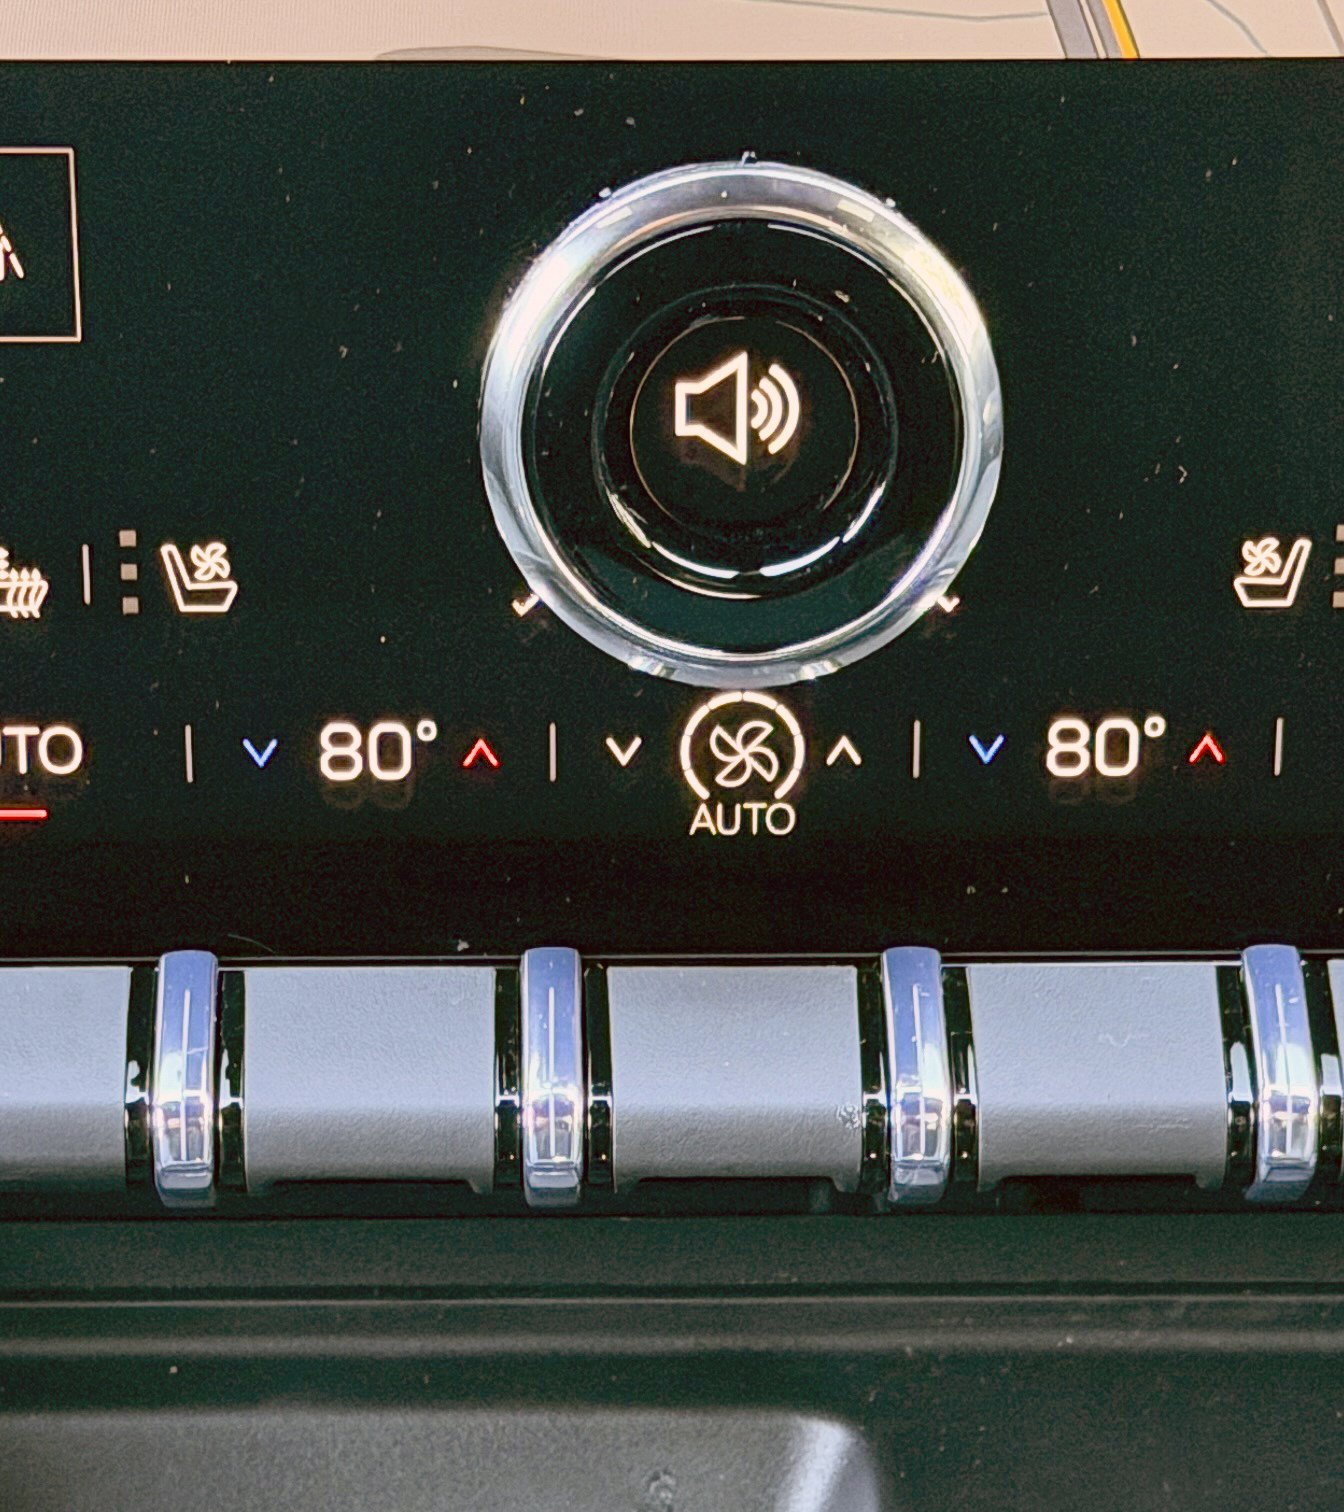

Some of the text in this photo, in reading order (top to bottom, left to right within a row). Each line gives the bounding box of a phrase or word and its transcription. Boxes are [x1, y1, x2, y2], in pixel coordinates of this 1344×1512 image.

[319, 719, 438, 782] 80°
[1045, 714, 1167, 778] 80°
[689, 801, 796, 836] AUTO
